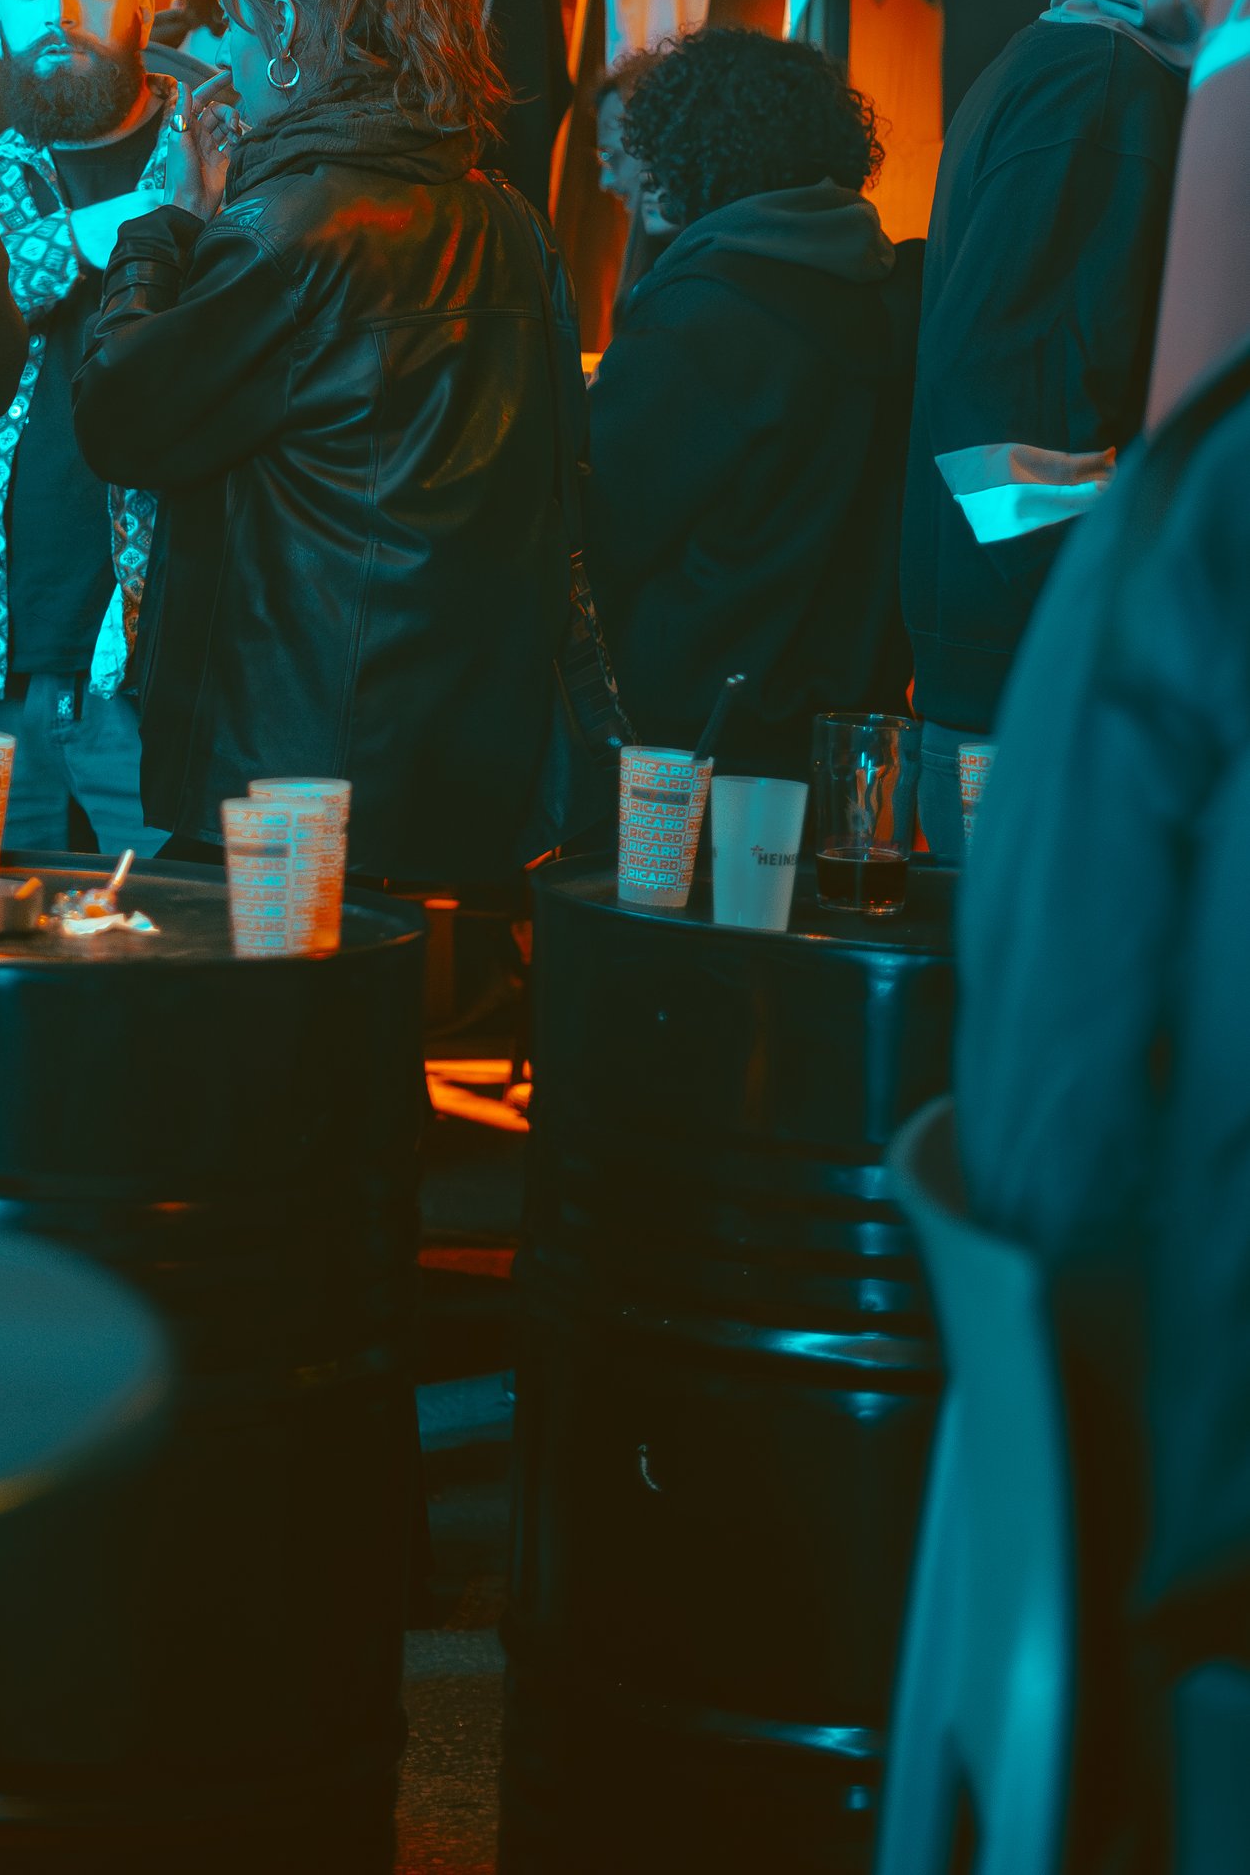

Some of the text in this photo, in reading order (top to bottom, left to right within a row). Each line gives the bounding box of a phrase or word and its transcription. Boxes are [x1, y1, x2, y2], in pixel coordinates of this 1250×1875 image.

[632, 760, 693, 777] RICARD
[632, 774, 691, 790] RICARD
[630, 801, 687, 817] RICARD
[629, 813, 685, 830] RICARD
[629, 827, 683, 843] RICARD
[629, 840, 681, 857] RICARD
[629, 854, 679, 870] RICARD
[628, 868, 677, 884] RICARD
